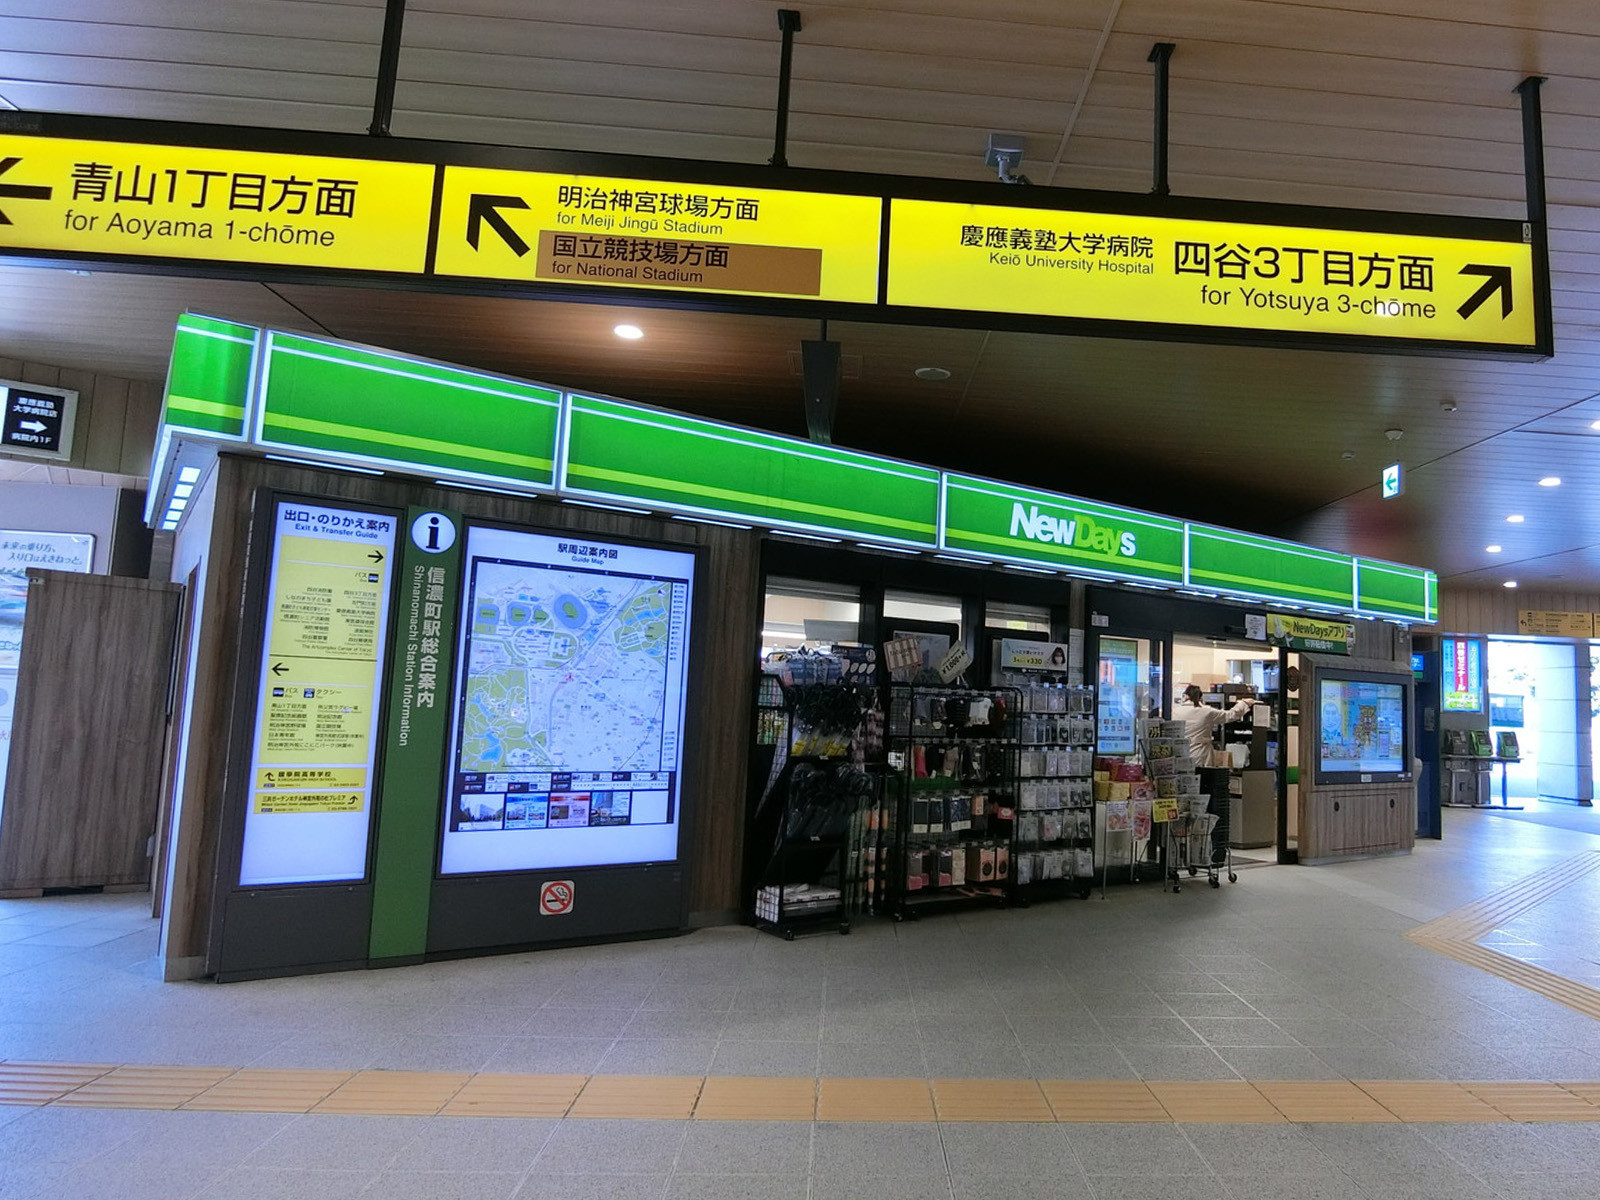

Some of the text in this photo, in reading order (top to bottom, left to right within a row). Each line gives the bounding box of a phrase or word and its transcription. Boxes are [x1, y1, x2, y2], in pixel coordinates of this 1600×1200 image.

[70, 162, 359, 219] 青山1丁目方面
[558, 185, 760, 221] 明治神宮球場方面
[65, 209, 336, 246] for Aoyama 1-chōme
[557, 212, 723, 235] for Meiji Jingū Stadium
[553, 235, 730, 268] 国立競技場方面
[960, 225, 1154, 259] 慶應義塾大学病院
[552, 261, 703, 283] for National Stadium
[989, 252, 1154, 275] Keiō University Hospital
[1174, 240, 1435, 292] 四谷3丁目方面
[1201, 285, 1436, 319] for Yotsuya 3-chōme
[284, 509, 390, 533] 出口・のりかえ案内
[295, 523, 310, 531] Exit
[321, 526, 354, 537] Transfer
[355, 531, 378, 539] Guide
[1009, 502, 1136, 557] NewDays
[557, 542, 618, 559] 駅周辺案内図
[571, 555, 605, 565] Guide Map
[416, 567, 446, 708] 信濃町駅総合案内
[399, 565, 425, 746] Shinanomachi Station Information
